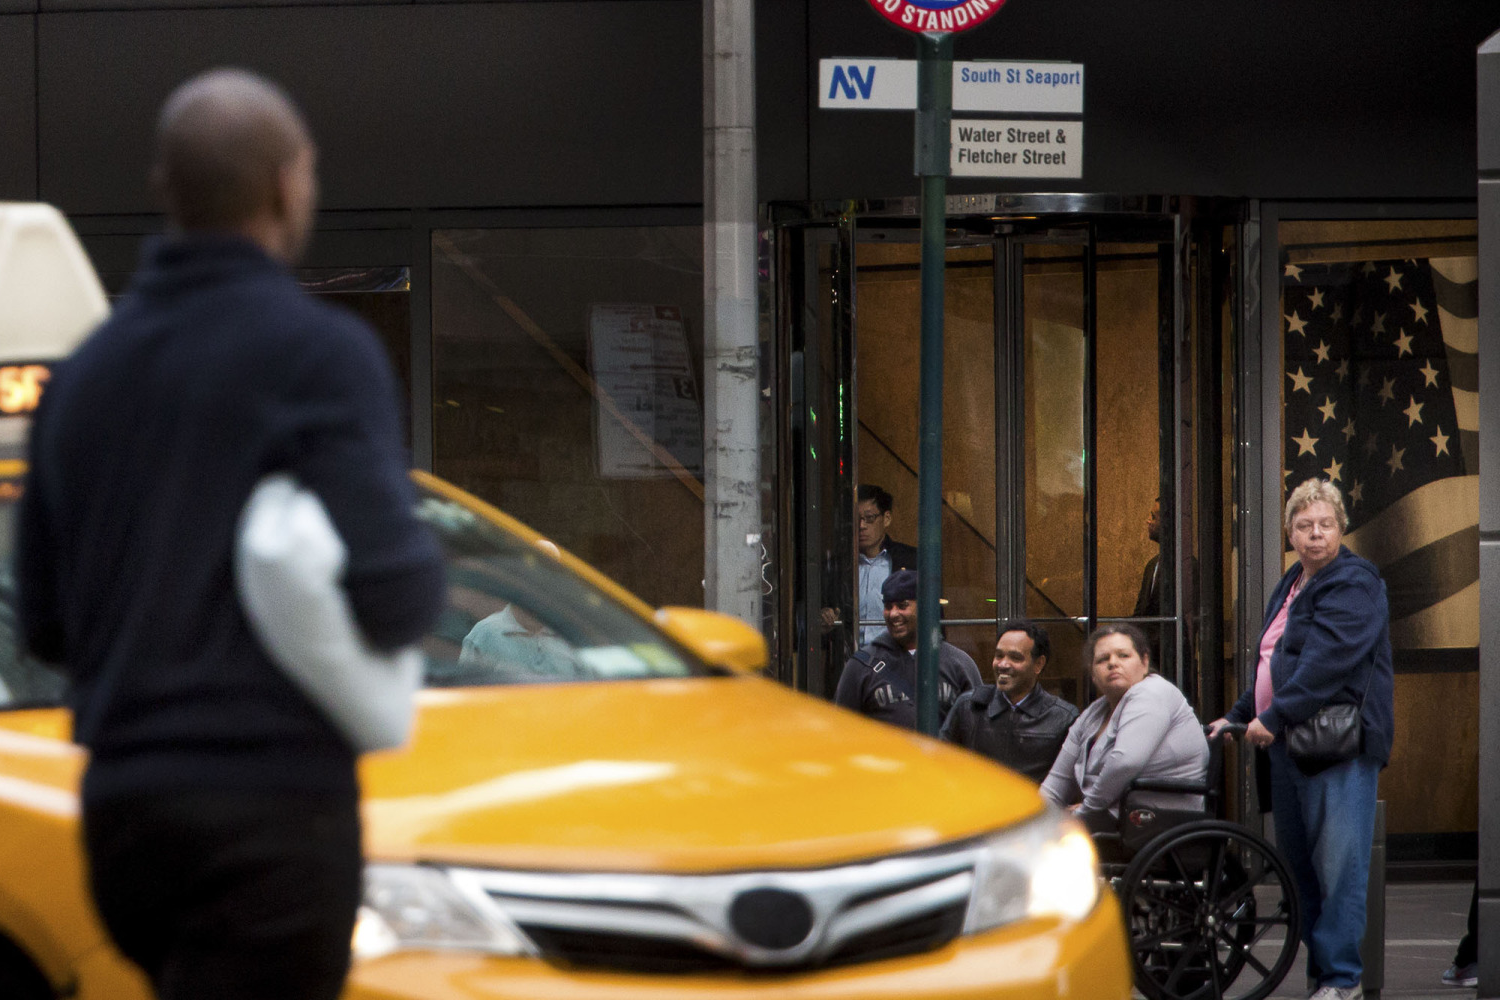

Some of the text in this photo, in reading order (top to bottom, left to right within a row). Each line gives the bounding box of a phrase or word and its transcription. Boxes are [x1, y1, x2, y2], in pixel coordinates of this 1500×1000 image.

[961, 67, 1080, 88] South St Seaport
[958, 126, 1066, 144] Water Street &
[958, 148, 1066, 165] Fletcher Street
